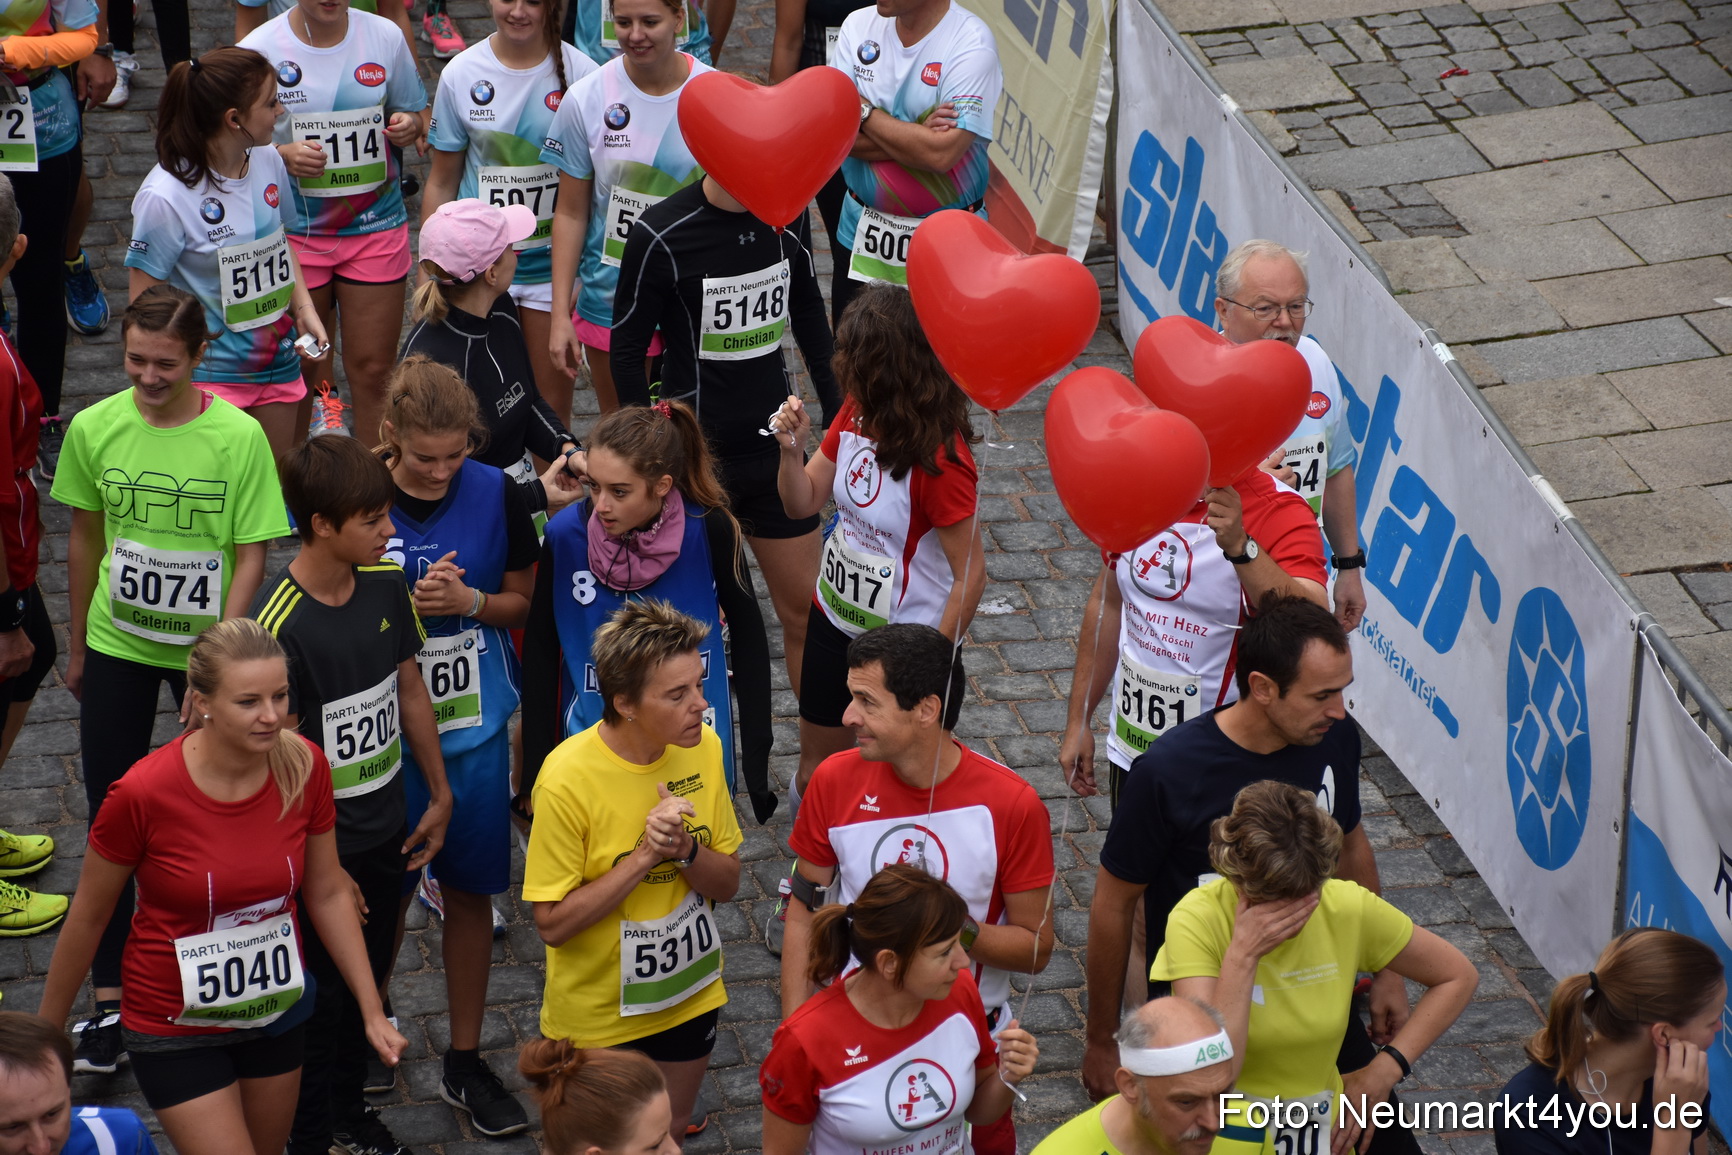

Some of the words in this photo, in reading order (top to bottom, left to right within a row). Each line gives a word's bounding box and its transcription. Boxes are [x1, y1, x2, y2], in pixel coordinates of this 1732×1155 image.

[278, 91, 307, 99] PARTL
[0, 109, 26, 139] 2
[295, 121, 327, 130] PARTL
[328, 117, 371, 128] Neumarkt
[305, 128, 380, 164] 114
[330, 172, 360, 185] Anna
[481, 175, 509, 184] PARTL
[511, 172, 554, 184] Neumarkt
[612, 194, 643, 209] PARTL
[207, 225, 234, 238] PARTL
[209, 231, 236, 243] Neumarkt
[532, 225, 551, 238] ara
[221, 253, 252, 265] PARTL
[252, 240, 283, 258] Neumarkt
[231, 249, 290, 300] 5115
[706, 285, 739, 296] PARTL
[740, 274, 779, 292] Neumarkt
[255, 298, 278, 315] Lena
[713, 285, 785, 331] 5148
[723, 330, 775, 350] Christian
[1284, 445, 1315, 457] umarkt
[115, 546, 147, 565] PARTL
[148, 557, 202, 571] Neumarkt
[840, 548, 876, 575] Neumarkt
[119, 564, 211, 610] 5074
[572, 570, 597, 606] 8
[825, 547, 883, 610] 5017
[132, 610, 191, 633] Caterina
[831, 594, 866, 626] Claudia
[1145, 611, 1169, 626] MIT
[1173, 615, 1209, 638] HERZ
[1161, 633, 1194, 649] Röschl
[418, 656, 471, 698] 60
[1136, 674, 1181, 695] Neumarkt
[325, 705, 359, 722] PARTL
[360, 688, 391, 712] Neumarkt
[1122, 678, 1186, 731] 5161
[336, 700, 396, 761] 5202
[359, 756, 391, 781] Adrian
[860, 804, 880, 813] erima
[624, 929, 664, 939] PARTL
[665, 901, 699, 935] Neumarkt
[181, 943, 225, 961] PARTL
[227, 930, 279, 952] Neumarkt
[635, 913, 713, 979] 5310
[197, 944, 292, 1004] 5040
[207, 998, 279, 1020] Elisabeth
[844, 1054, 869, 1067] erima
[920, 1135, 942, 1151] MIT
